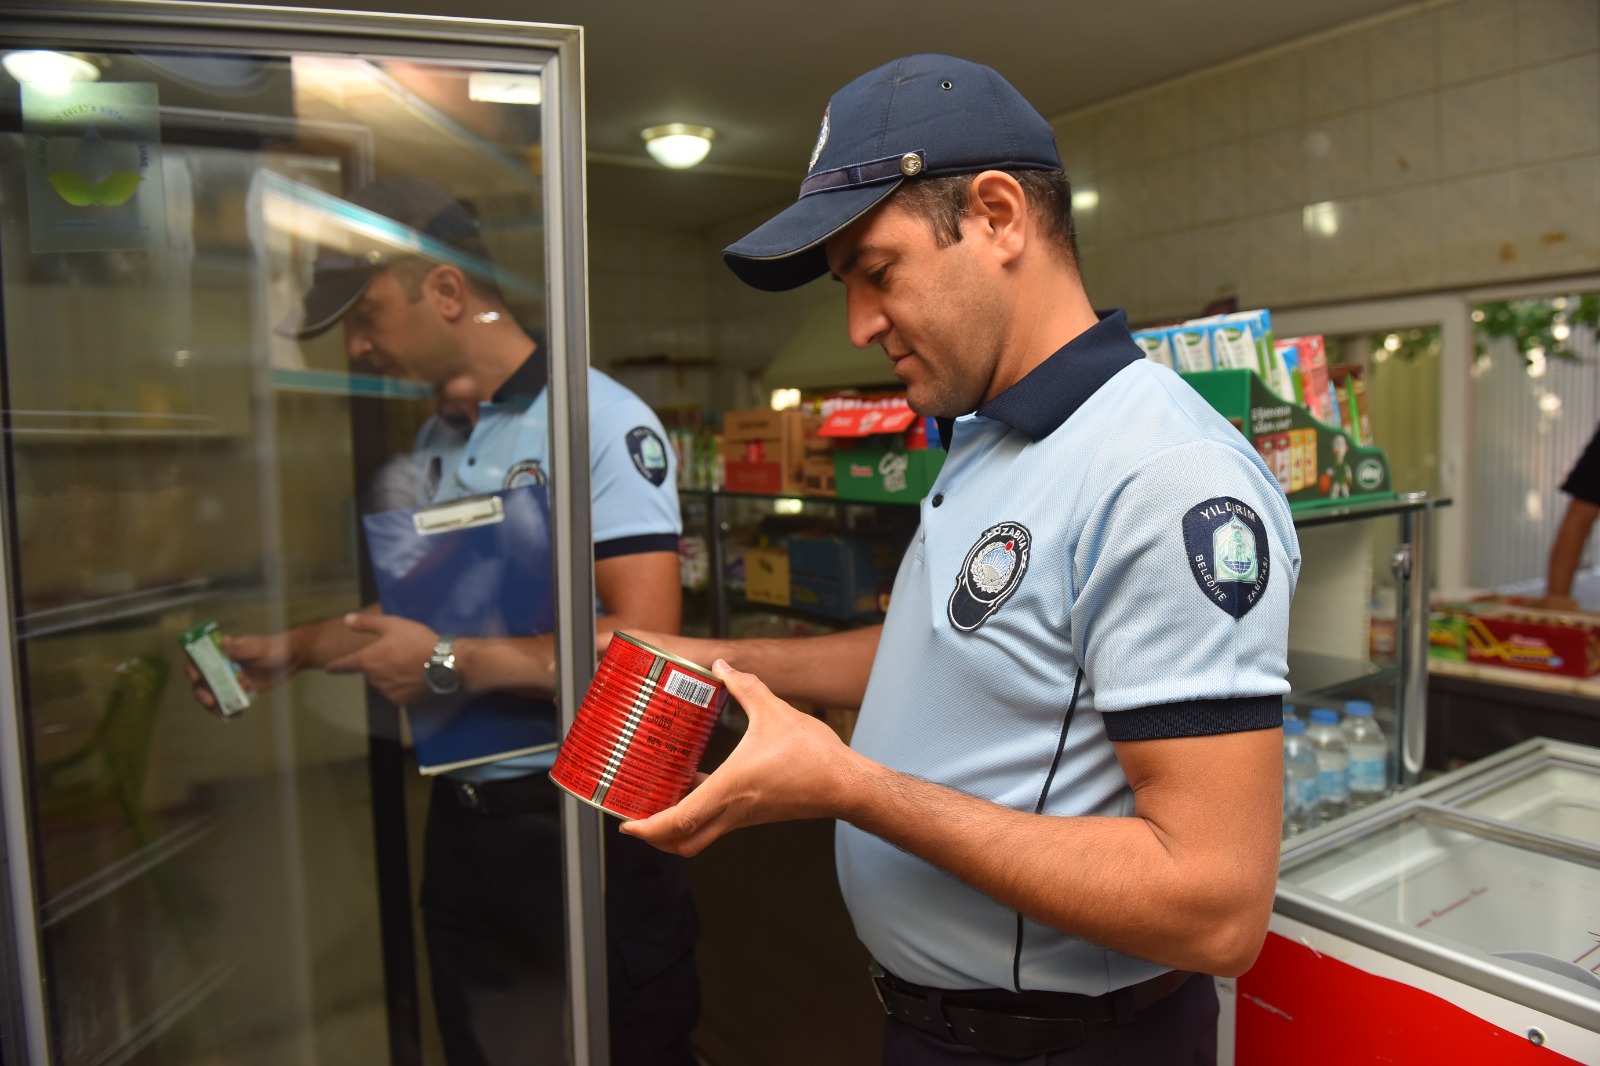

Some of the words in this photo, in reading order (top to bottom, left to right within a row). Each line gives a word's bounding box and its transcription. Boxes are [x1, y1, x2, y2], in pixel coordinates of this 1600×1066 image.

[1200, 502, 1255, 522] YILDIRIM
[1001, 527, 1027, 550] ZABITA
[1195, 554, 1227, 602] BELEDİYE
[1247, 556, 1269, 604] ZABITASI
